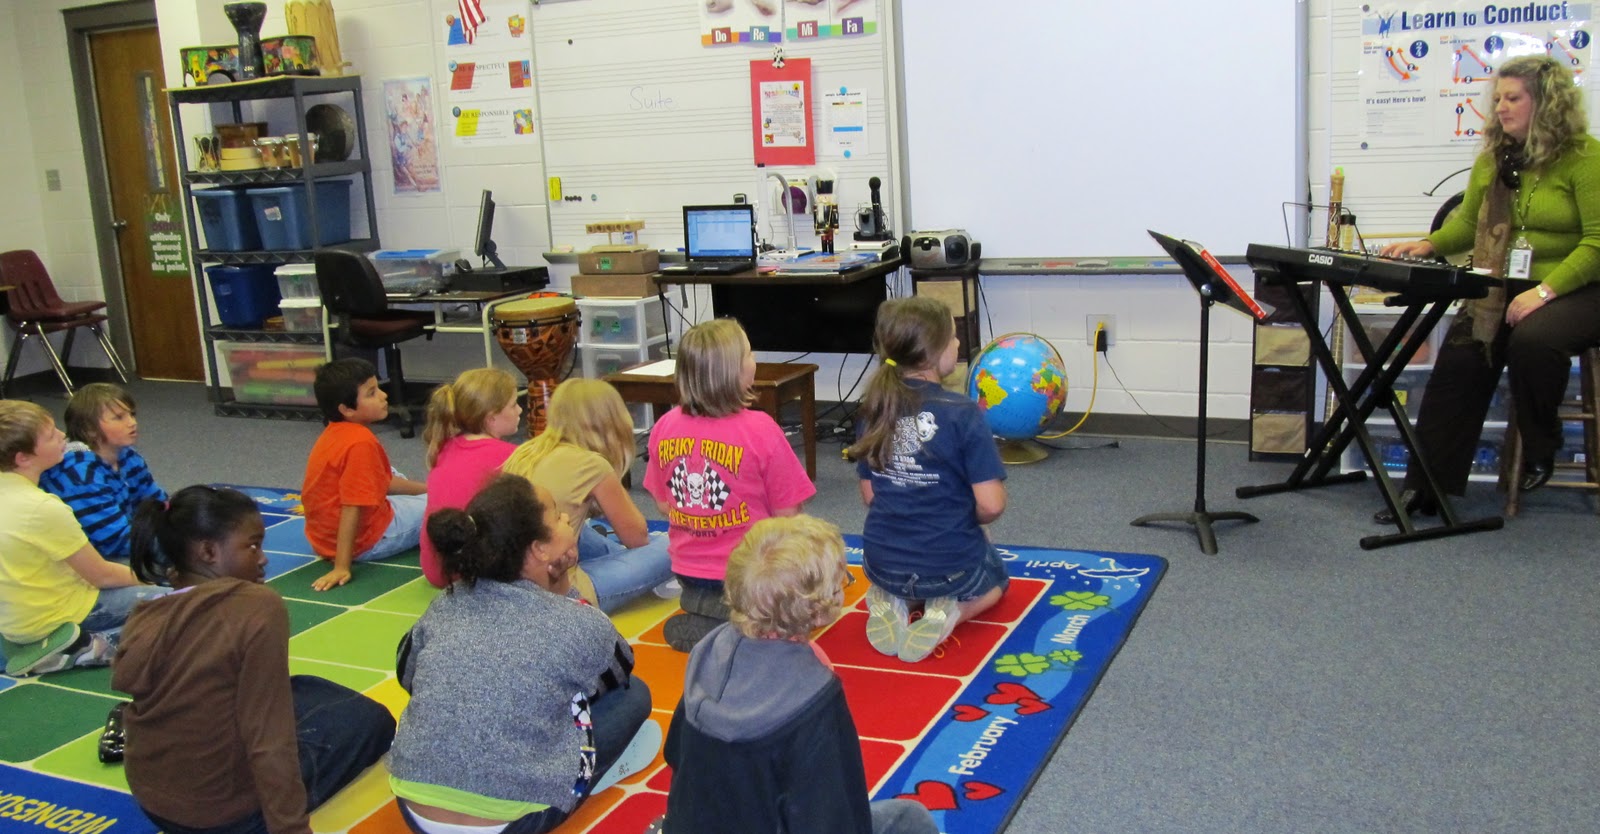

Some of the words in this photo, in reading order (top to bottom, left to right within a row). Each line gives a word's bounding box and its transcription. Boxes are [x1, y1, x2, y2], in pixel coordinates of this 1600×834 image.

[1401, 11, 1456, 30] Learn
[1463, 12, 1477, 26] to
[1484, 1, 1568, 25] Conduct
[802, 23, 813, 36] Mi
[847, 20, 858, 33] Fa
[715, 30, 727, 42] Do
[753, 28, 765, 40] Re
[630, 86, 673, 112] Suite
[155, 212, 170, 223] Only
[150, 232, 182, 242] attitudes
[152, 242, 182, 251] allowed
[154, 252, 182, 263] beyond
[1308, 253, 1334, 266] CASIO
[658, 437, 695, 470] FREAKY
[700, 439, 744, 480] FRIDAY
[1025, 560, 1081, 570] April
[1050, 613, 1091, 644] March
[948, 715, 1018, 776] February
